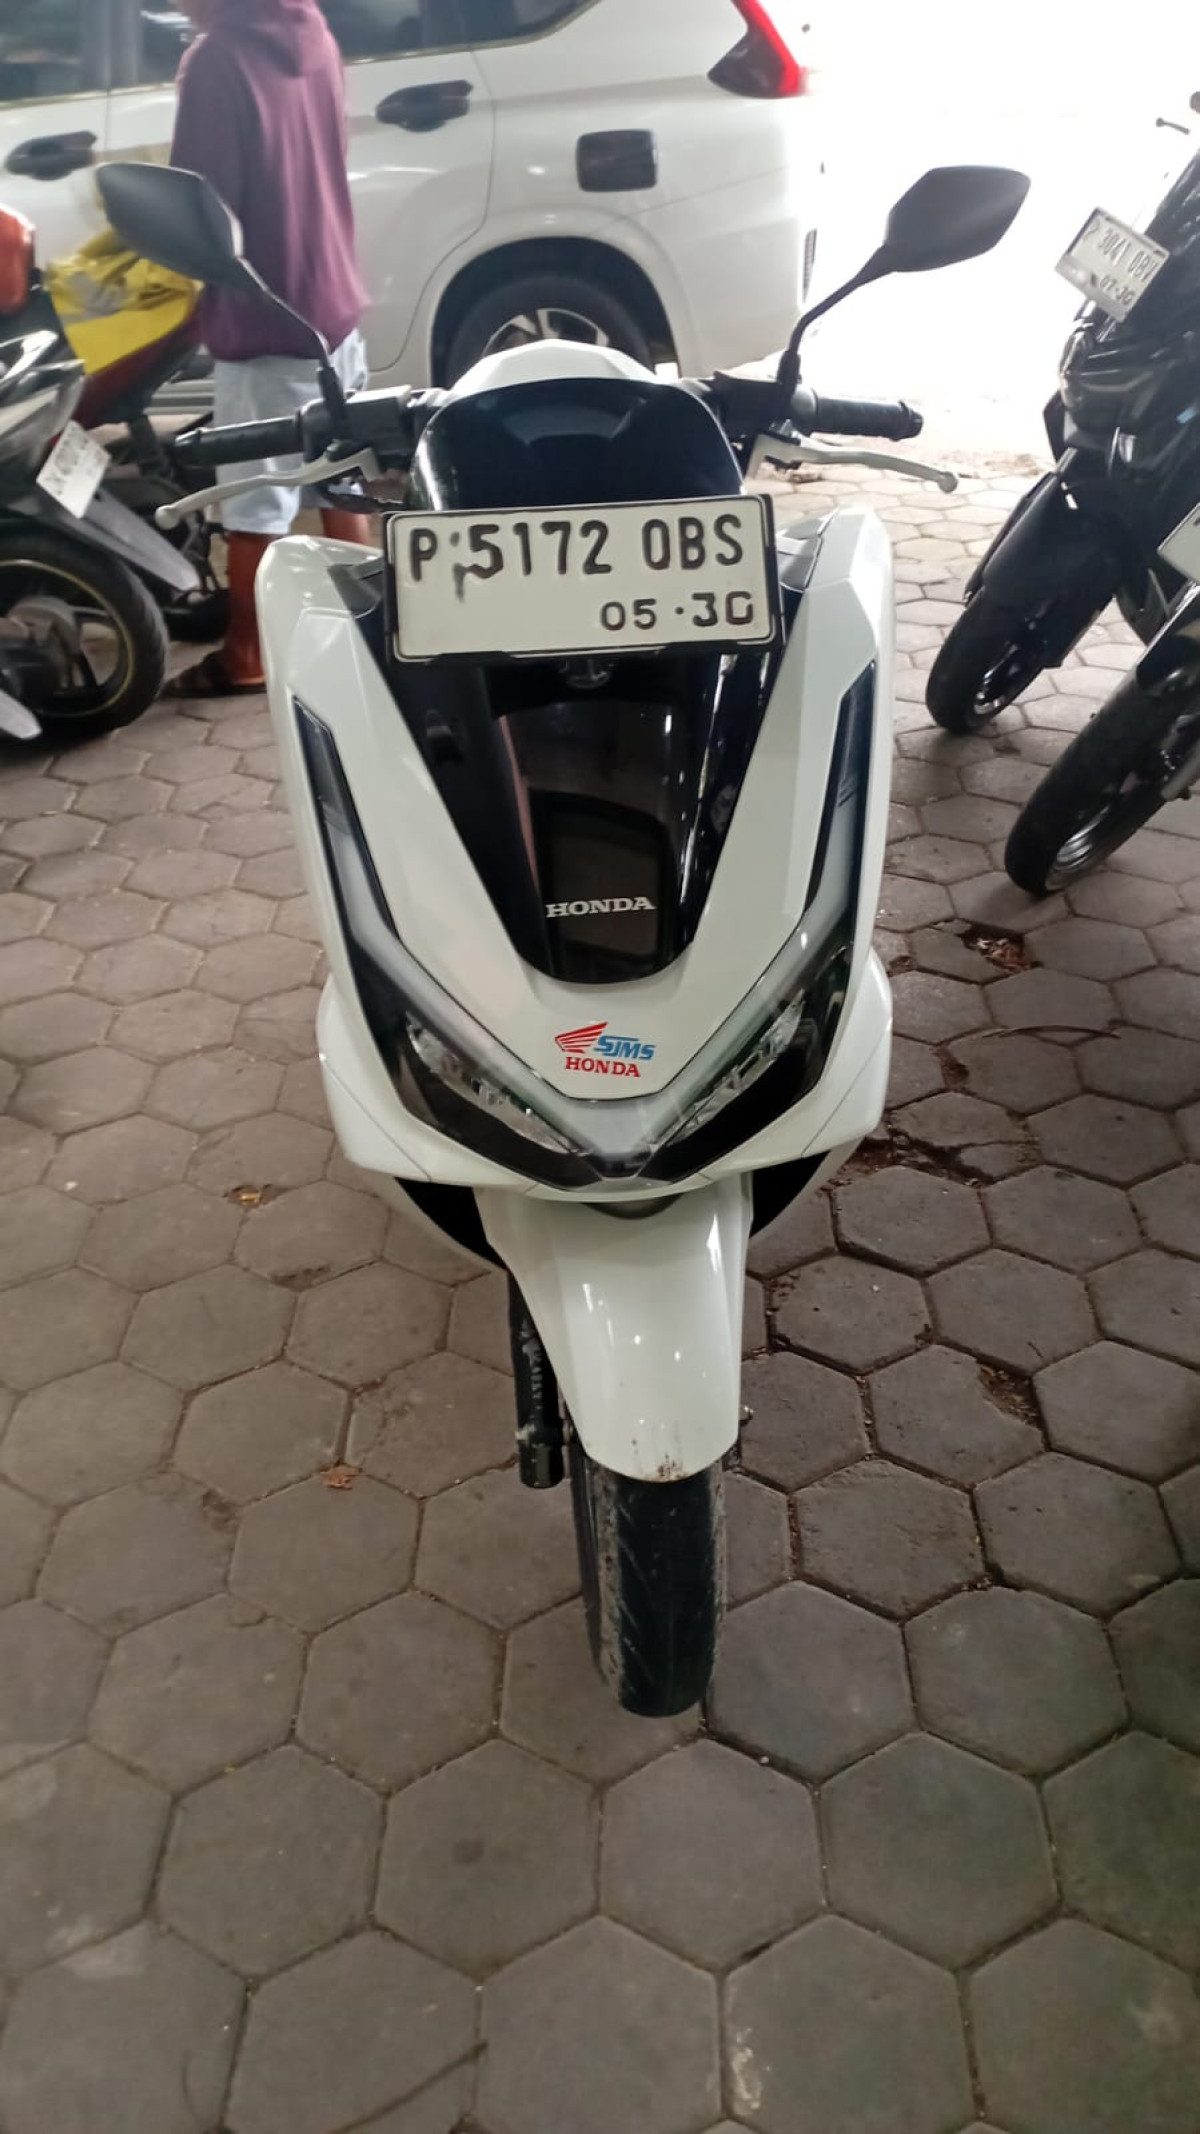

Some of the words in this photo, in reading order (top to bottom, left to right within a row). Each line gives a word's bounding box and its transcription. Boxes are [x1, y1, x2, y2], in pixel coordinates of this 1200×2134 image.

[409, 527, 438, 582] P
[464, 520, 613, 580] 5172
[641, 513, 744, 571] OBS
[545, 896, 657, 919] HONDA
[564, 1056, 641, 1078] HONDA
